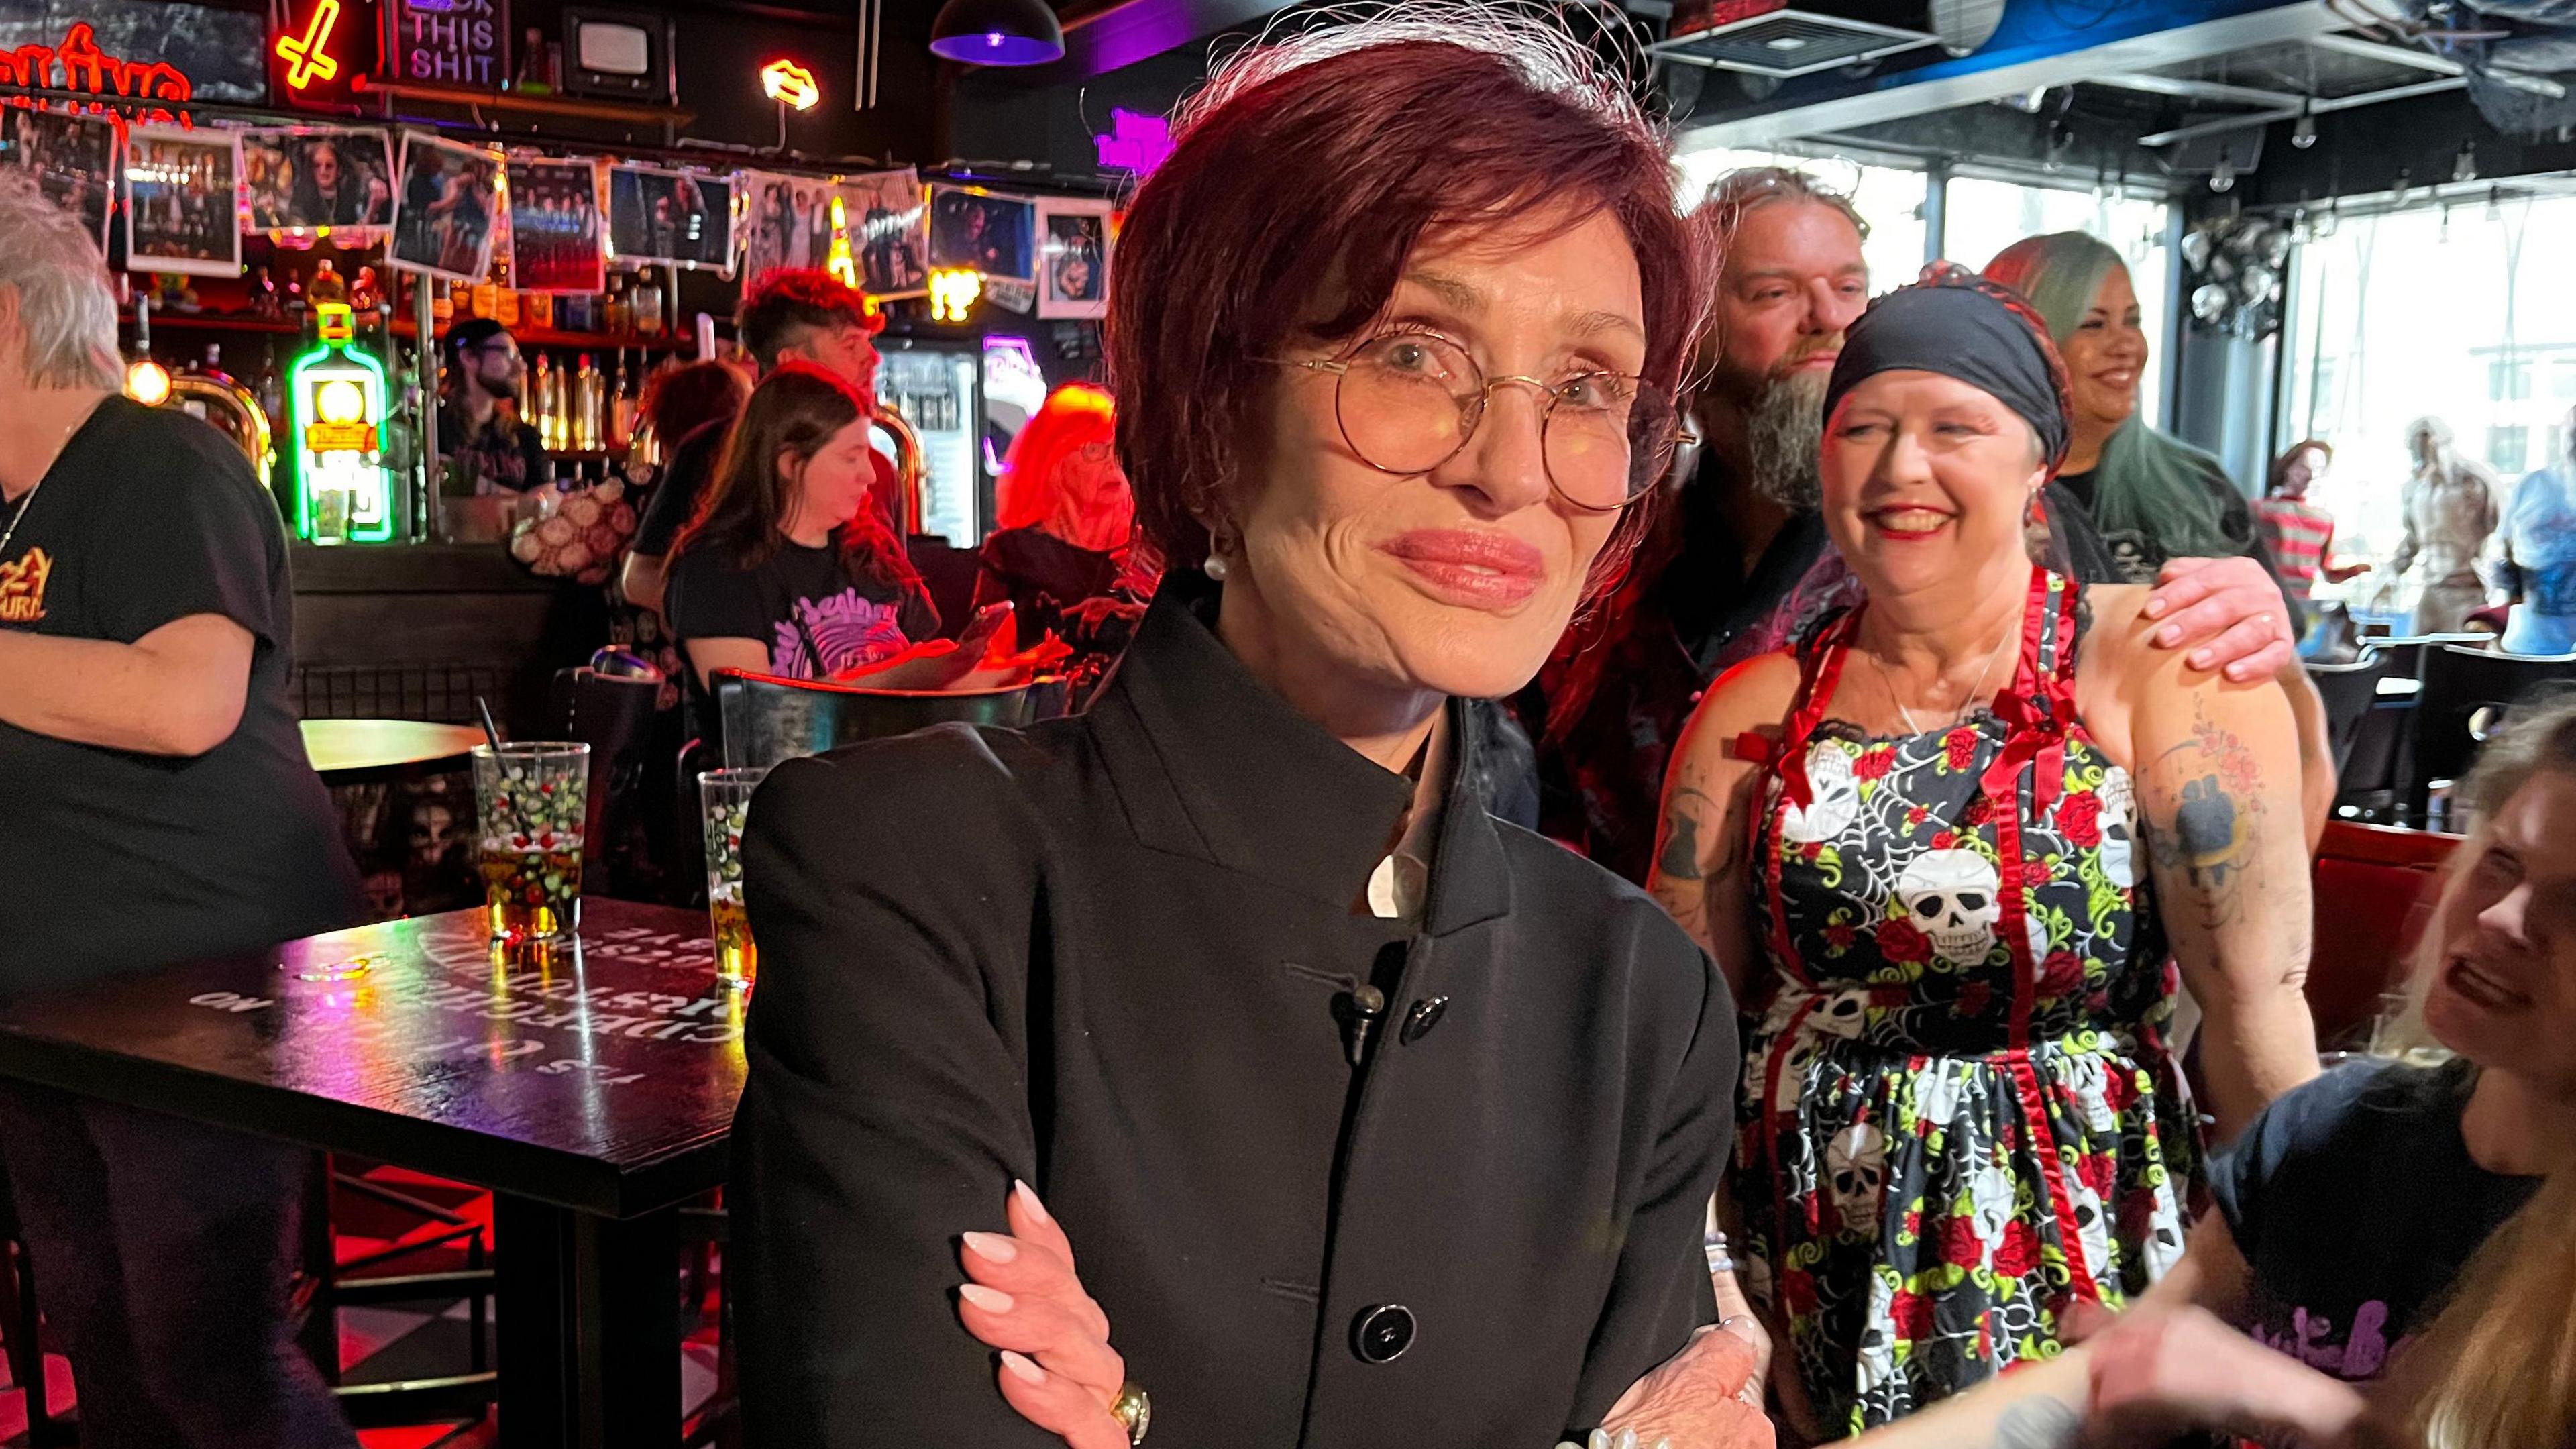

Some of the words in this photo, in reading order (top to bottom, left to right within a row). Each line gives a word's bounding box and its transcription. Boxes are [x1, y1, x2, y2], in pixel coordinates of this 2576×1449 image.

[409, 13, 494, 50] THIS
[411, 48, 494, 85] SHIT
[189, 992, 274, 1012] NO
